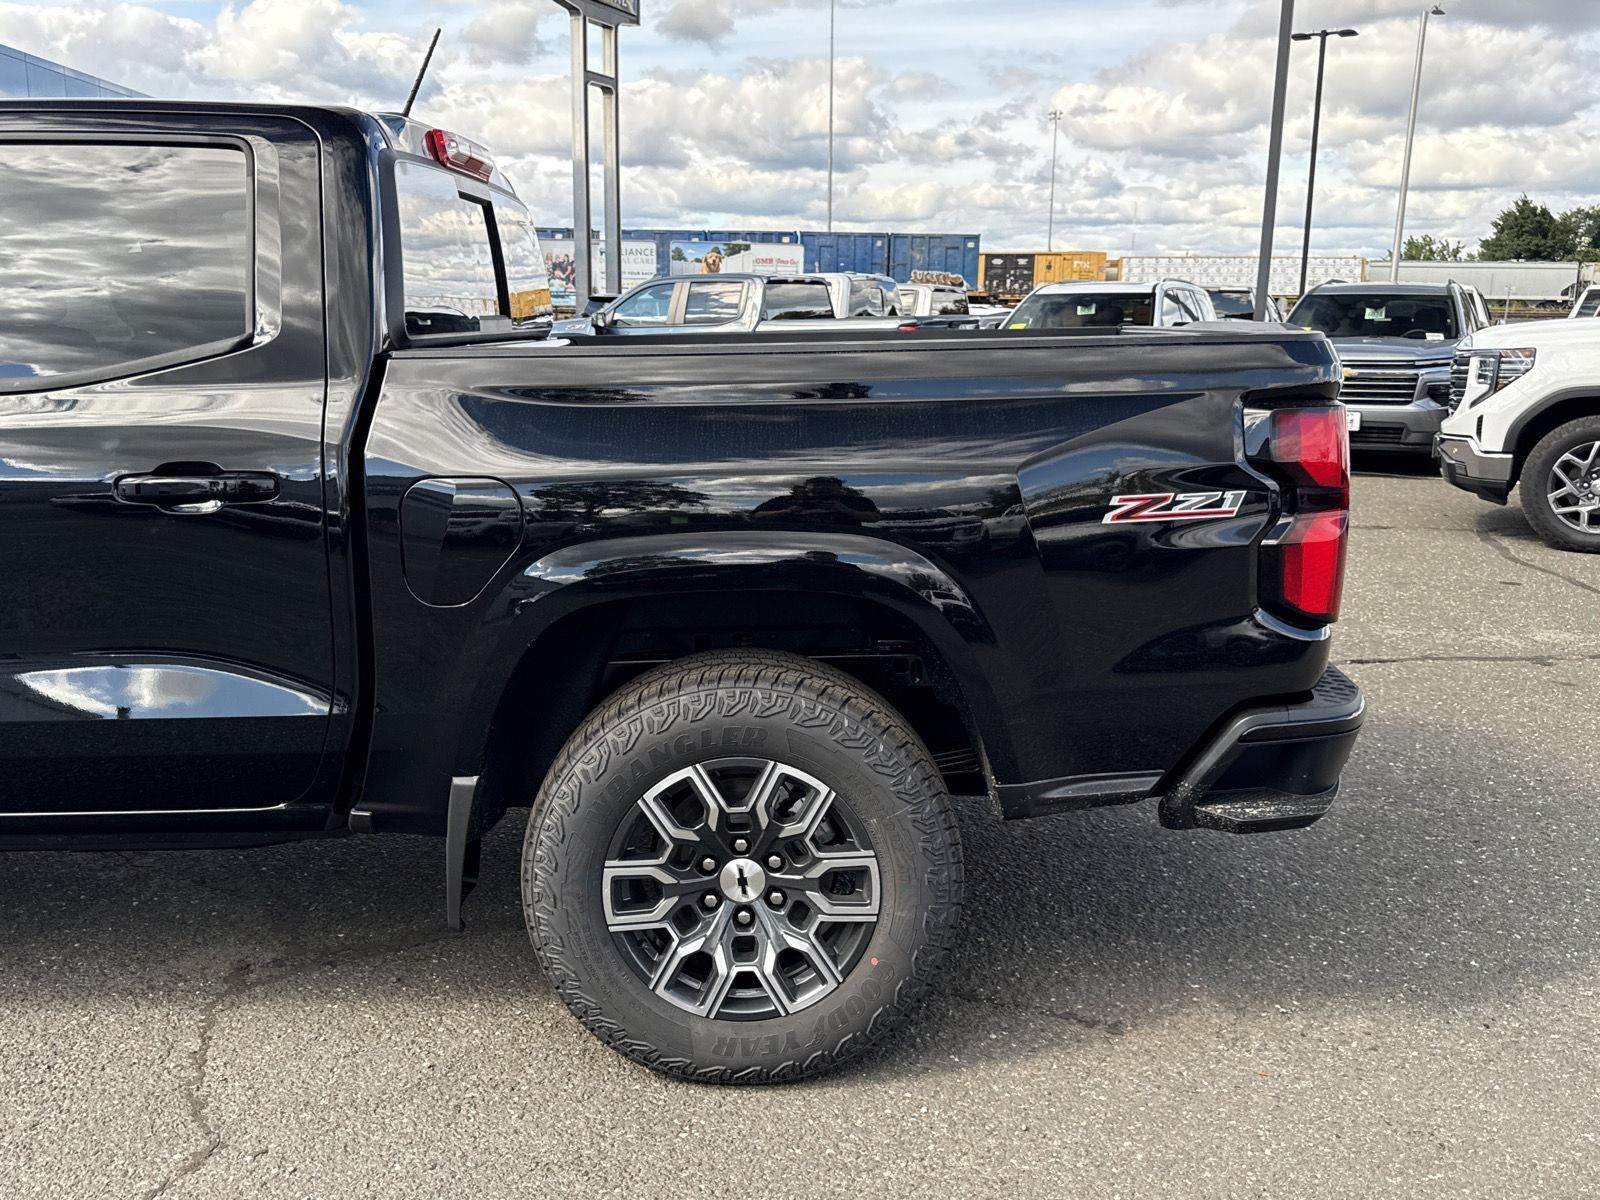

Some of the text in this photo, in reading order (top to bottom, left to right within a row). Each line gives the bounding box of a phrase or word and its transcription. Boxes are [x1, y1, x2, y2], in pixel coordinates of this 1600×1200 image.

[620, 247, 655, 257] LIANCE
[1101, 489, 1247, 525] Z71
[584, 725, 770, 822] WRANGLER
